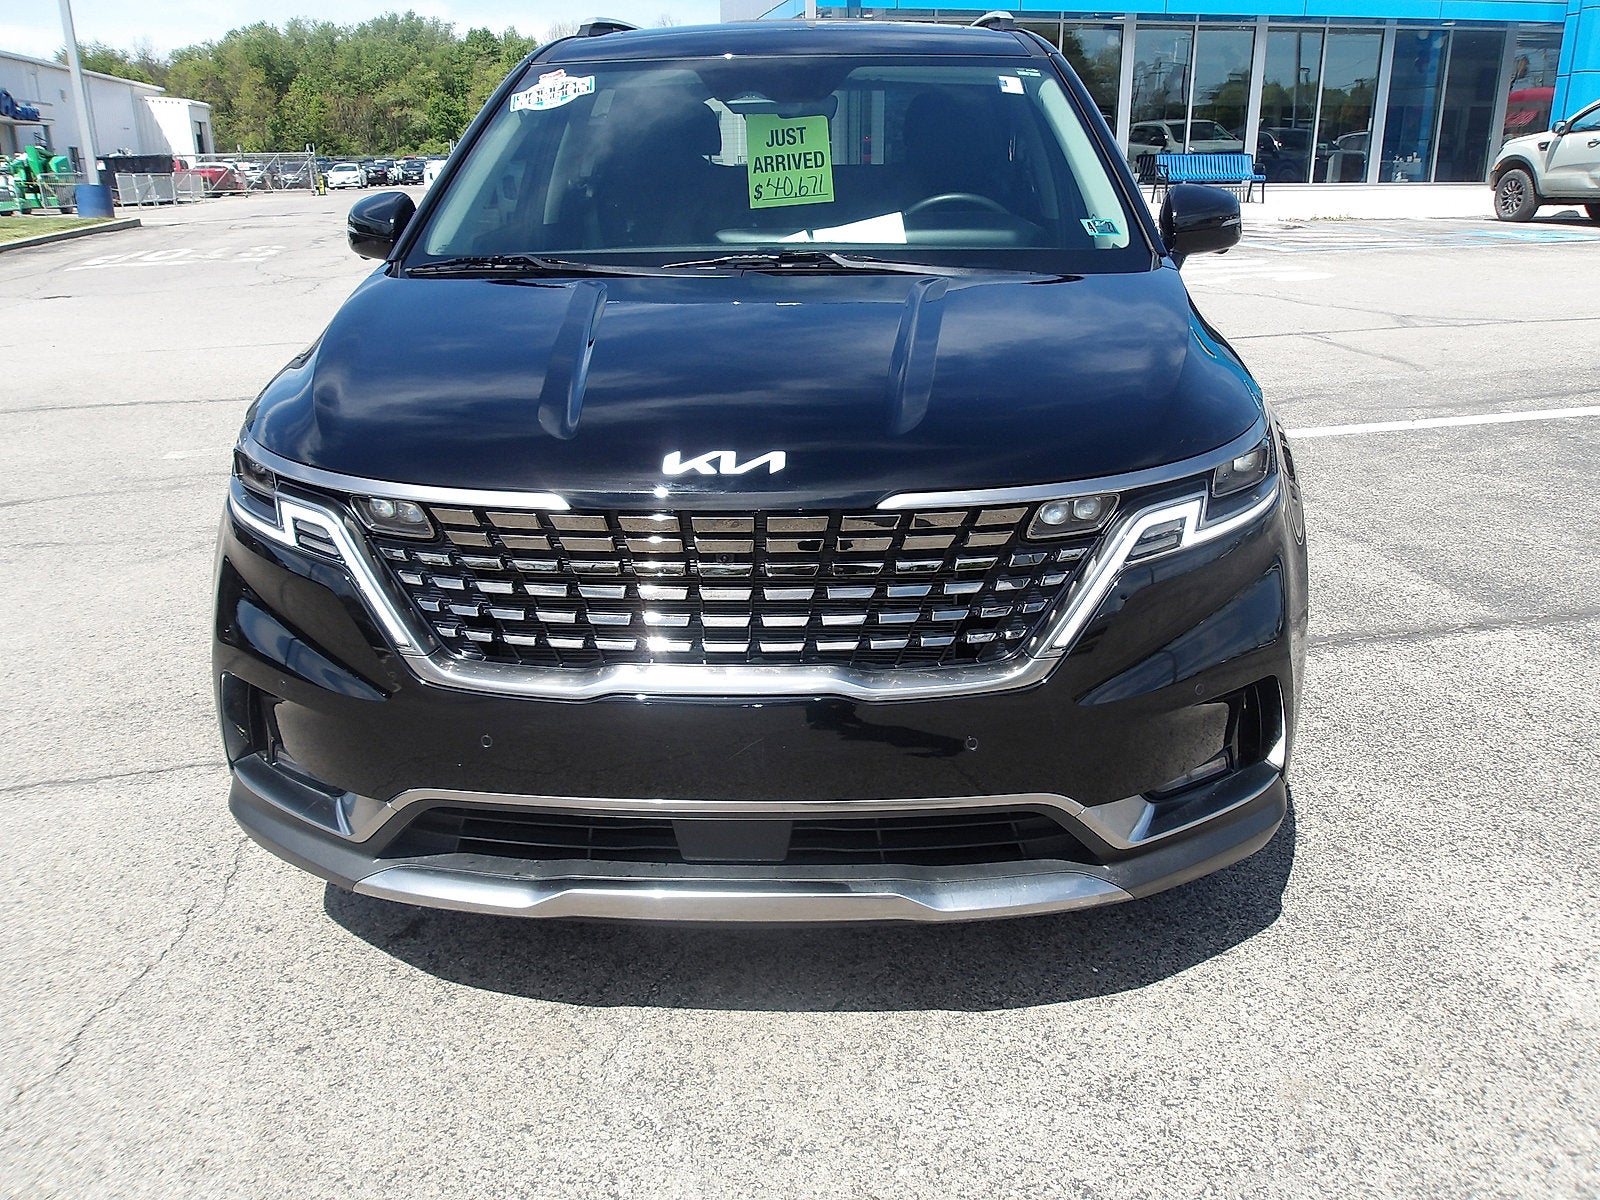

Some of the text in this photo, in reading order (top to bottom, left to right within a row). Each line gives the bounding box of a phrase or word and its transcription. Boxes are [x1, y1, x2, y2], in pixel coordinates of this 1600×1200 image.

[766, 126, 807, 147] JUST
[753, 151, 825, 174] ARRIVED
[754, 174, 824, 201] $40,671
[662, 450, 787, 475] KIA
